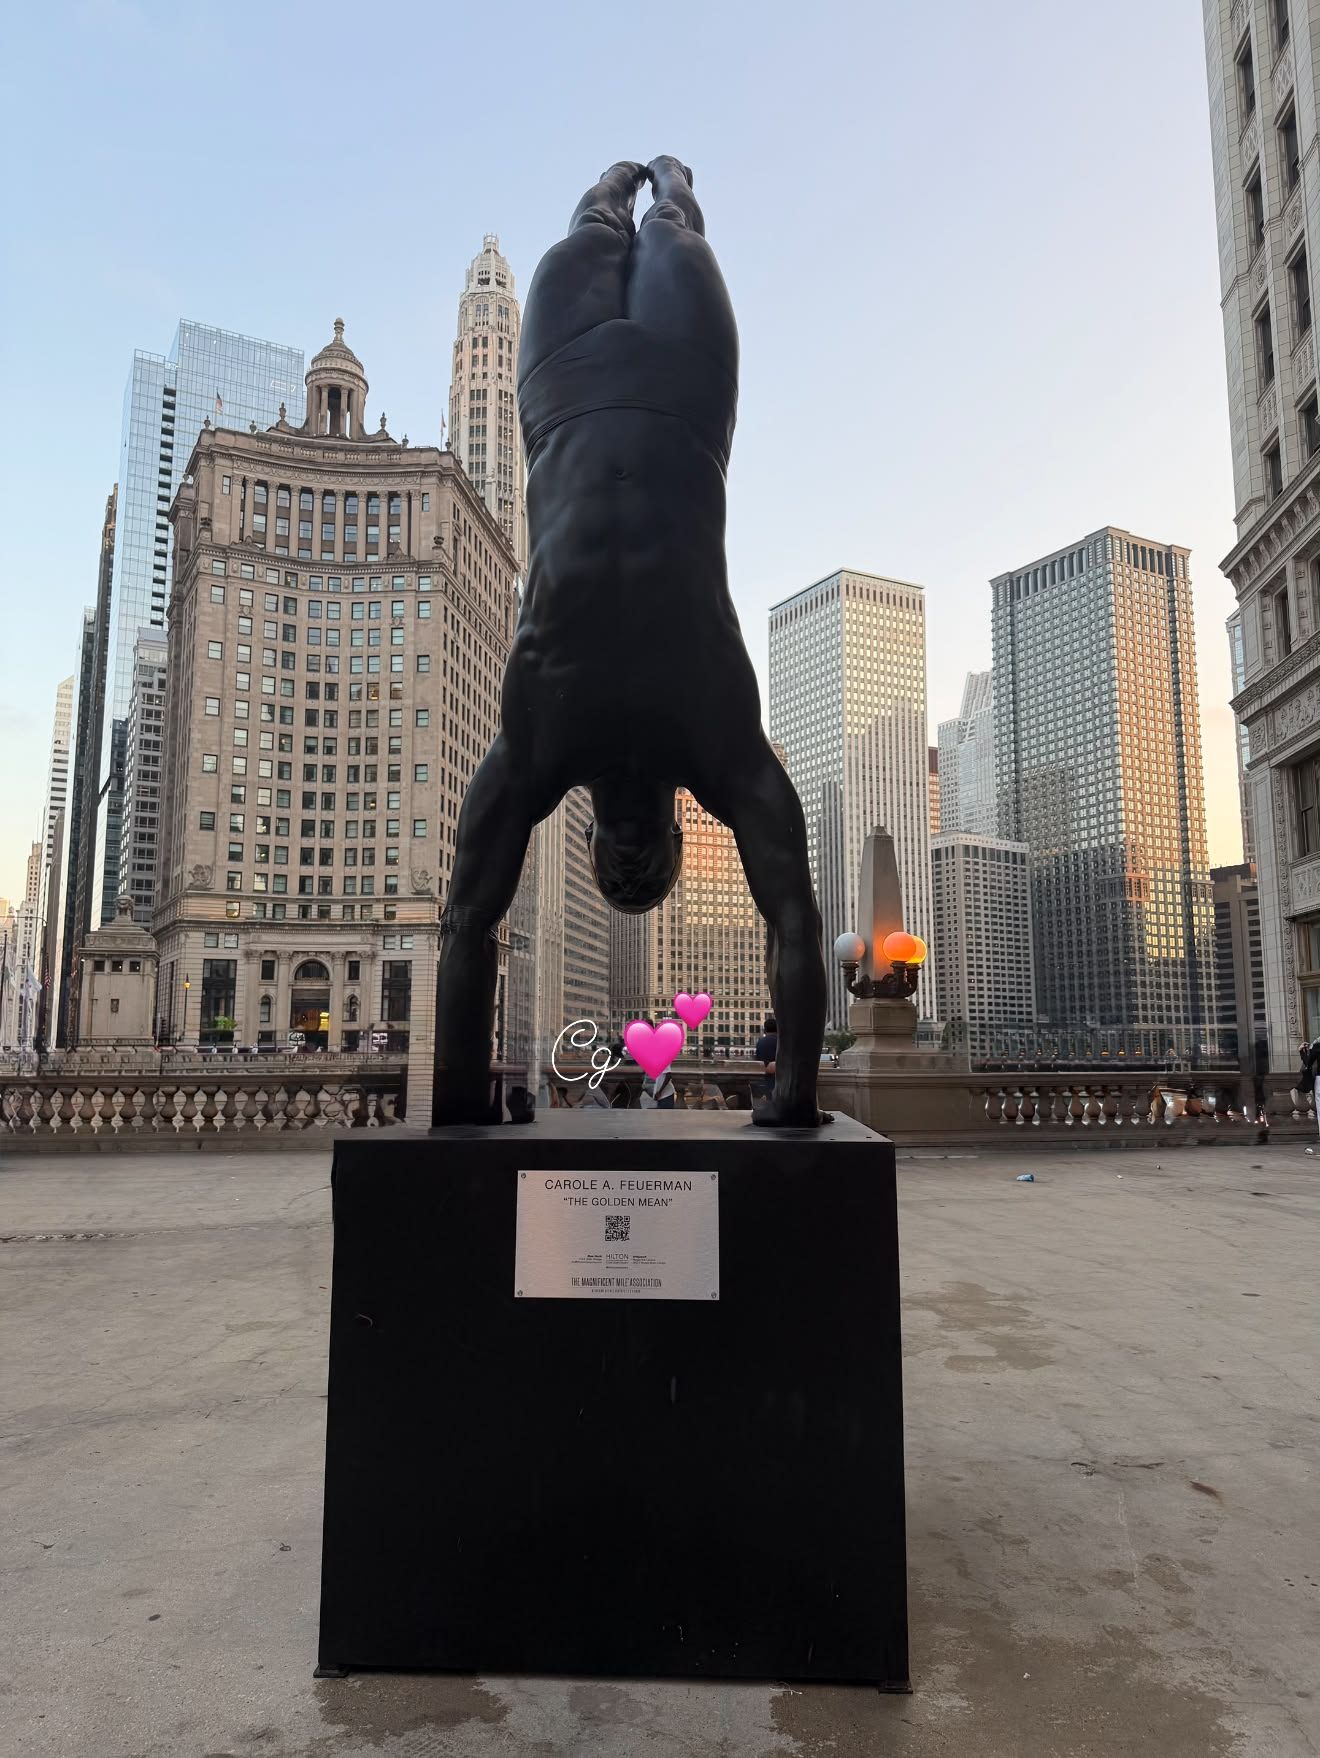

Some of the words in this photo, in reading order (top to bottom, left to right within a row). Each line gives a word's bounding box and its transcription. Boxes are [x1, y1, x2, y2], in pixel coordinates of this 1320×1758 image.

[544, 1179, 598, 1190] CAROLE
[602, 1180, 614, 1190] A.
[620, 1180, 692, 1191] FEUERMAN
[591, 1197, 635, 1207] GOLDEN
[571, 1277, 580, 1287] THE
[581, 1277, 616, 1287] MAGNIFICENT
[629, 1278, 662, 1288] ASSOCIATION
